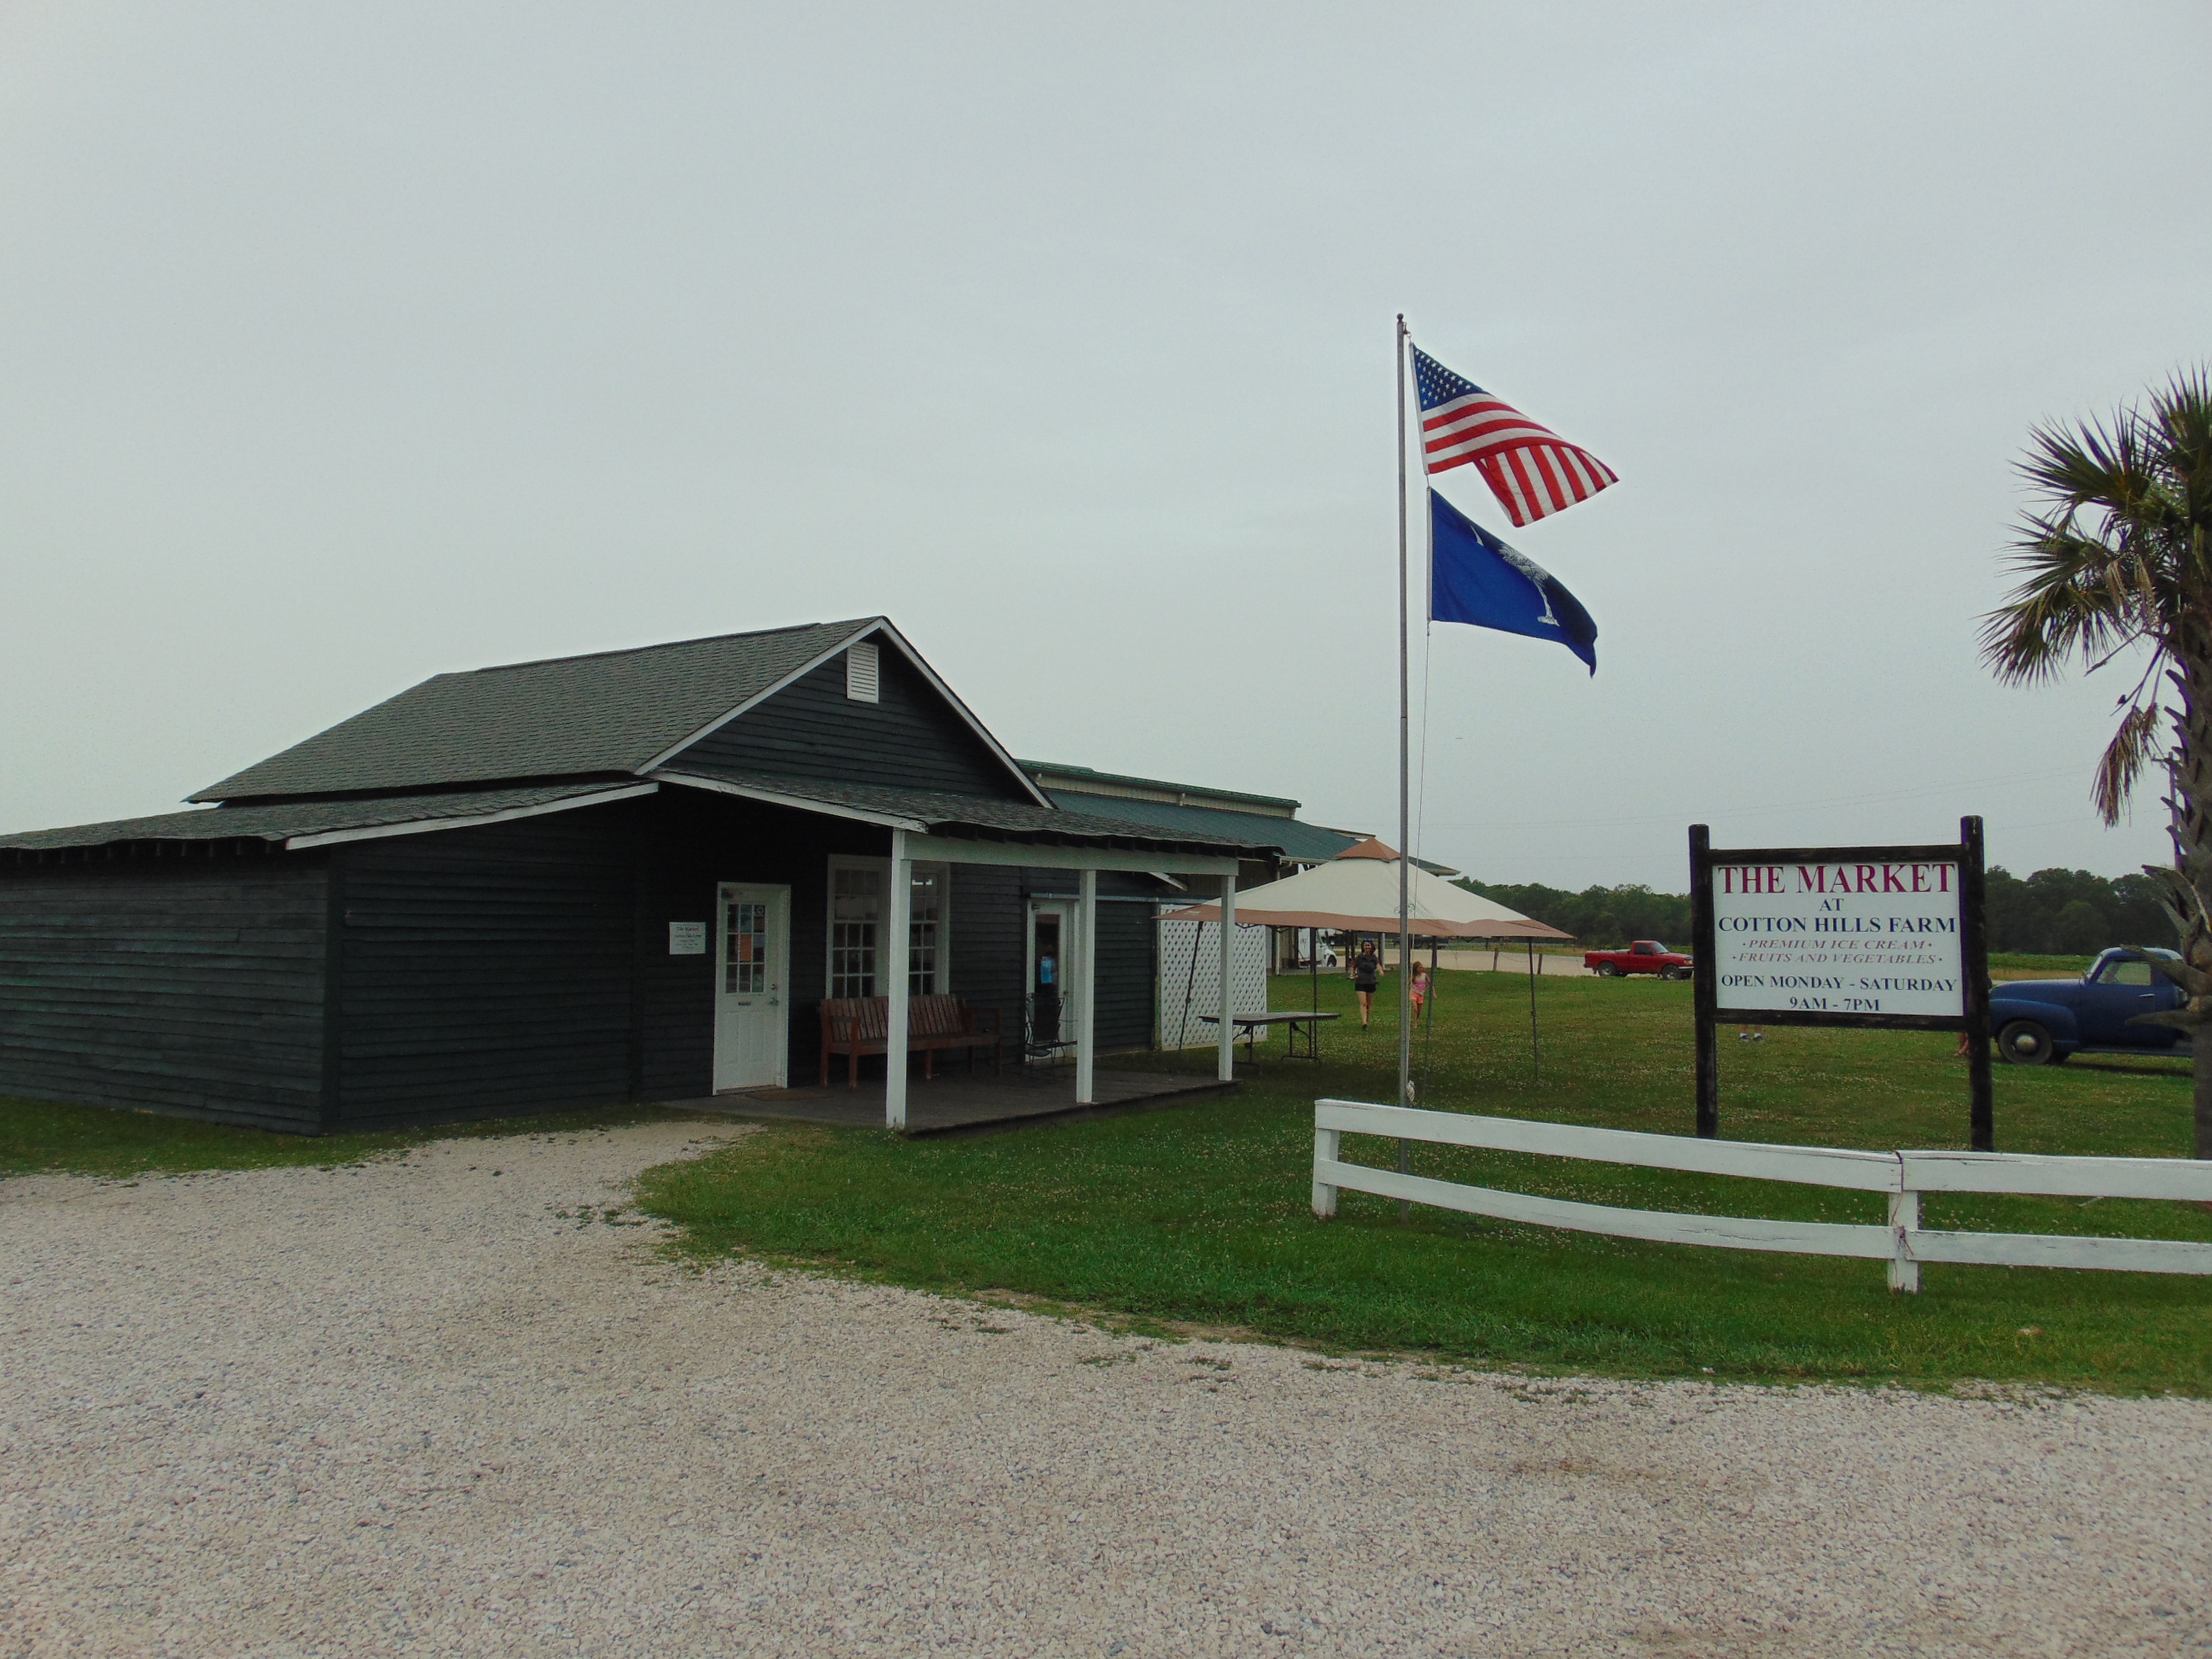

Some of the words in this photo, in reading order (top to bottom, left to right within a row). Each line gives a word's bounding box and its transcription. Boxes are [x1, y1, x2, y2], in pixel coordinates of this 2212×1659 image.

[1718, 865, 1786, 894] THE
[1796, 863, 1955, 894] MARKET
[1819, 898, 1843, 911] AT
[1718, 917, 1807, 933] COTTON
[1814, 917, 1881, 933] HILLS
[1888, 917, 1957, 934] FARM
[1748, 939, 1826, 949] PREMIUM
[1831, 940, 1860, 949] ICE
[1864, 940, 1927, 950] CREAM
[1738, 952, 1793, 963] FRUITS
[1794, 953, 1828, 963] AND
[1832, 953, 1936, 964] VEGETABLES
[1721, 975, 1765, 987] OPEN
[1770, 975, 1844, 989] MONDAY
[1860, 977, 1958, 992] SATURDAY
[1790, 996, 1828, 1010] 9AM
[1843, 998, 1881, 1012] 7PM
